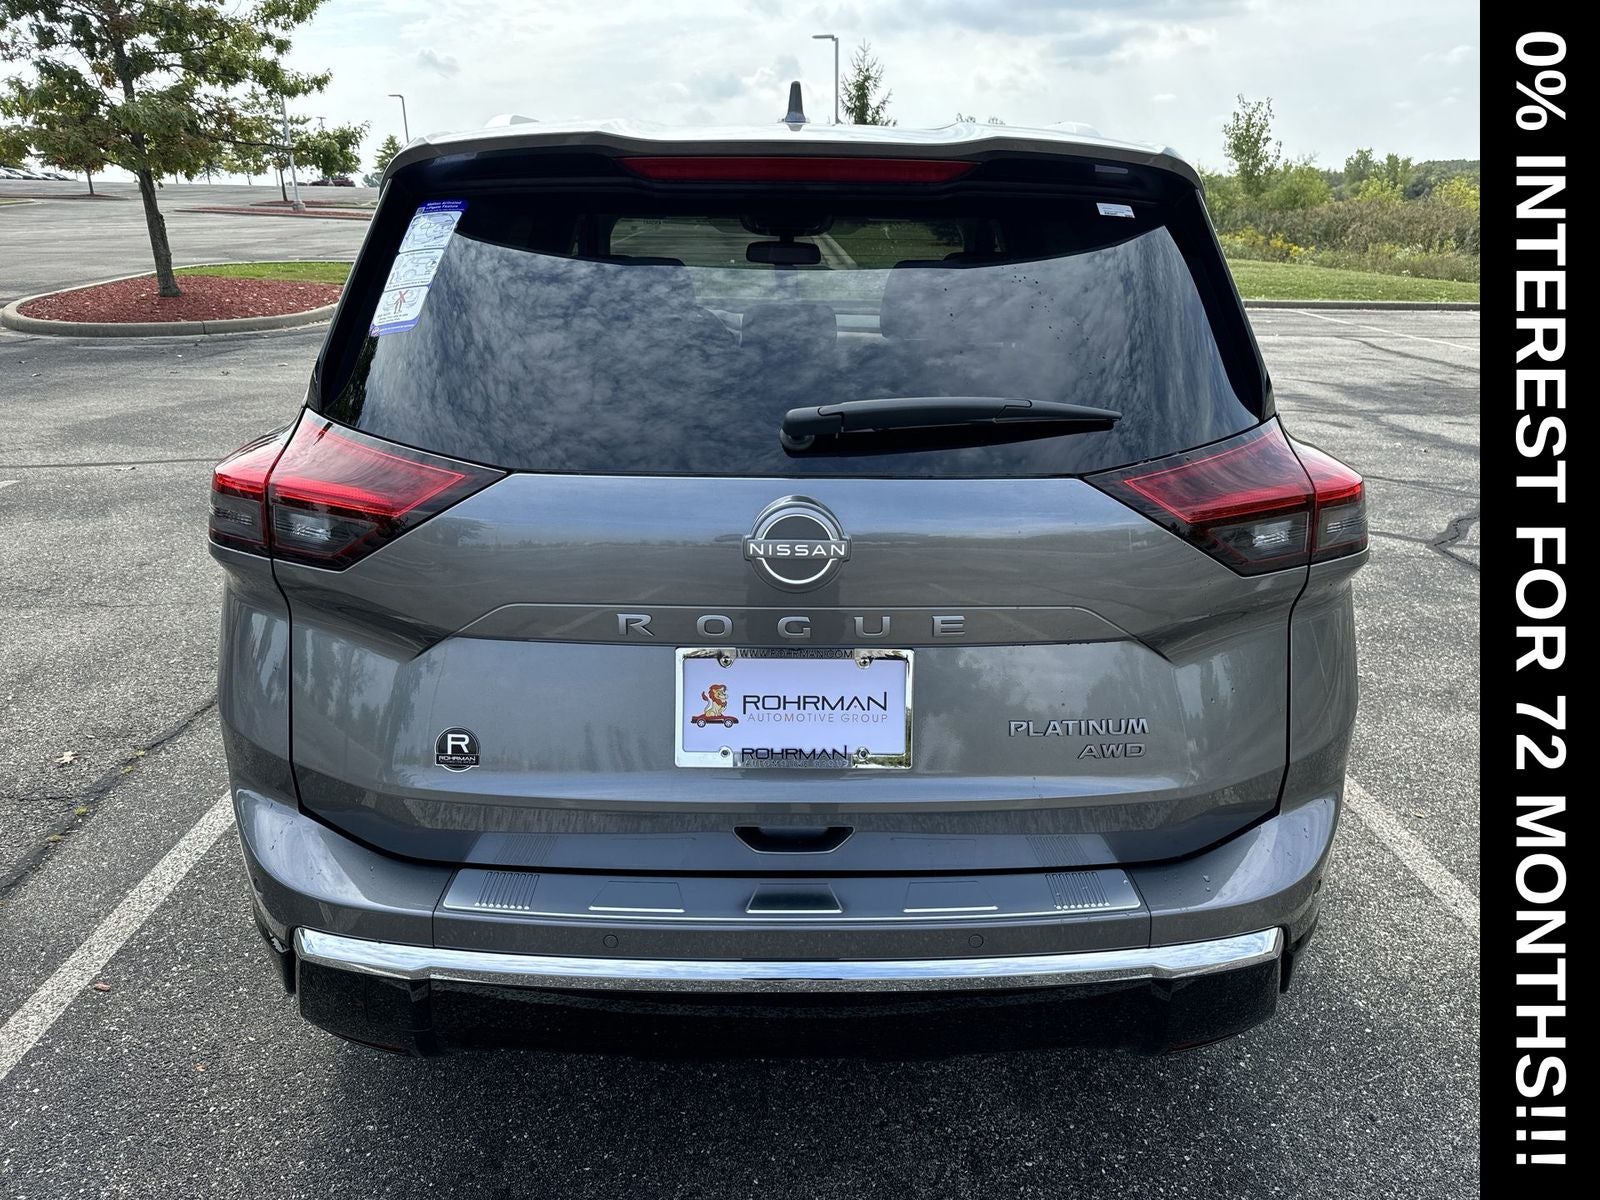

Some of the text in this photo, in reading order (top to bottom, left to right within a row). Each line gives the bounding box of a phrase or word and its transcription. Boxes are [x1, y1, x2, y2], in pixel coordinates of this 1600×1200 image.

[749, 543, 845, 557] NISSAN
[616, 613, 967, 640] ROGUE
[738, 648, 854, 659] WWW.ROHRMAN.COM
[742, 691, 888, 715] ROHRMAN
[747, 712, 888, 723] AUTOMOTIVE GROUP
[1008, 718, 1150, 737] PLATINUM
[447, 733, 470, 755] R
[741, 744, 848, 762] ROHRMAN
[1077, 742, 1147, 760] AWD
